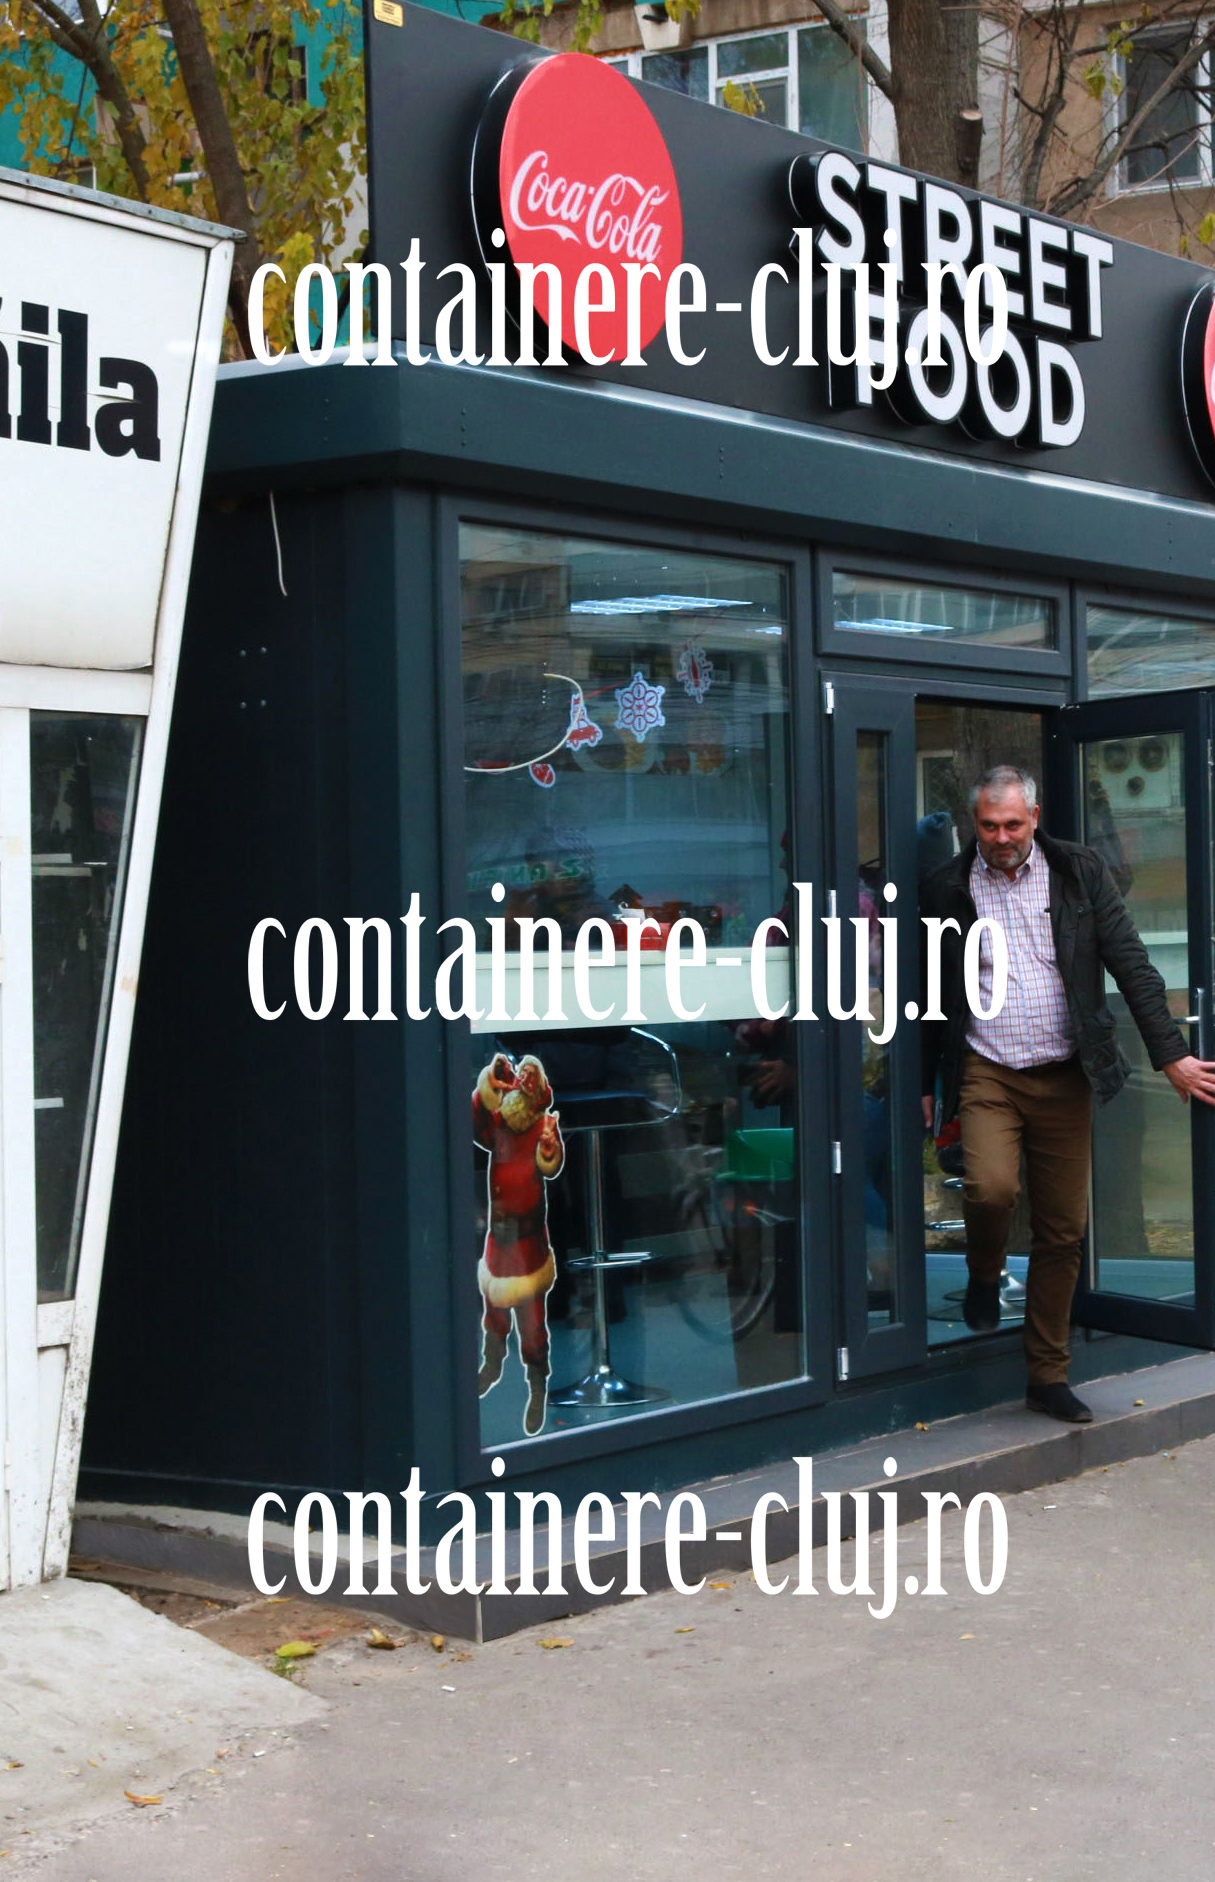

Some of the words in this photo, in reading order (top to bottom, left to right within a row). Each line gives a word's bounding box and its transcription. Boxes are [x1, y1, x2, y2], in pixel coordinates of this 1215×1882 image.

[509, 150, 669, 262] Coca-Cola
[812, 150, 1114, 340] STREET
[0, 299, 161, 462] ila
